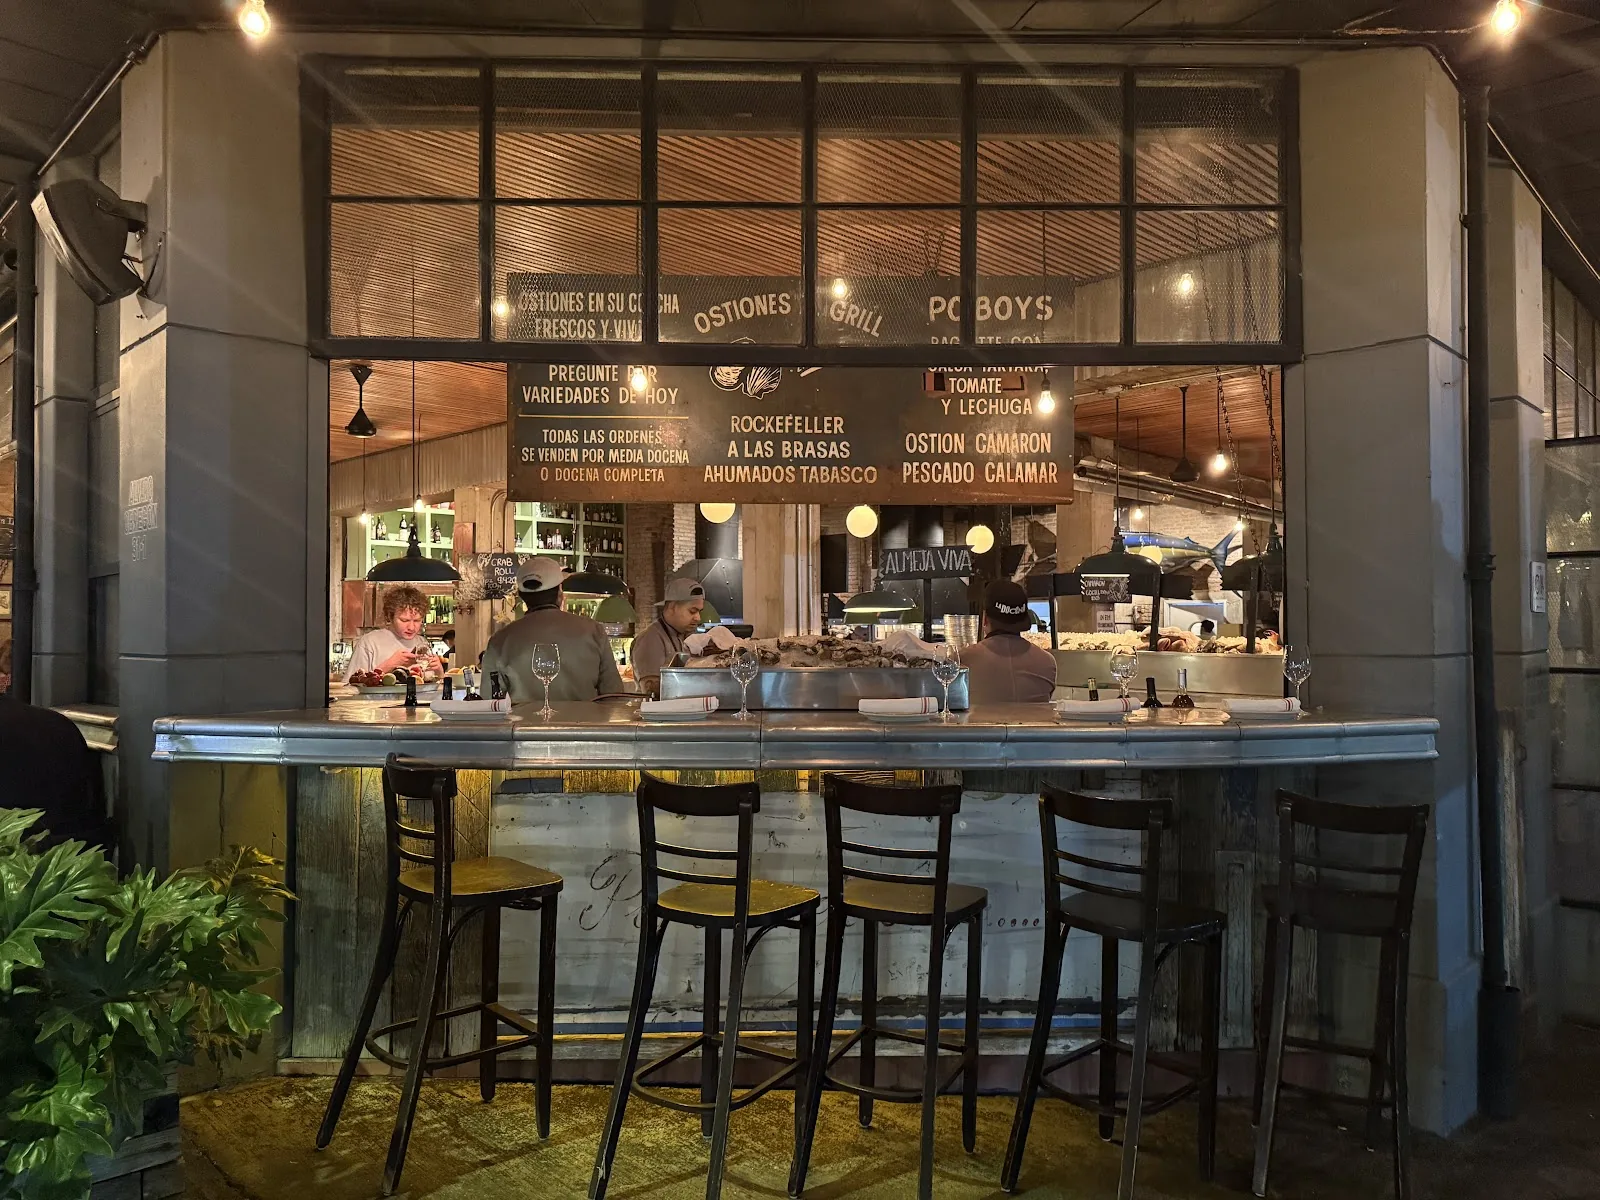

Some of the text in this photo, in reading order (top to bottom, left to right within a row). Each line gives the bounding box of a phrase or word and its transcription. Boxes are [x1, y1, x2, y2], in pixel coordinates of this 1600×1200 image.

[519, 292, 584, 313] OSTIONES
[588, 292, 604, 313] EN
[608, 292, 624, 313] SU
[975, 295, 1053, 321] BOYS
[693, 292, 883, 338] OSTIONES GRILL
[534, 318, 596, 339] FRESCOS
[600, 319, 610, 338] Y
[549, 364, 658, 383] PREGUNTE PR
[522, 385, 679, 405] VARIEDADES DE HOY
[949, 377, 1002, 394] TOMATE
[941, 398, 1033, 415] Y LECHUGA
[730, 415, 844, 434] ROCKEFELLER
[543, 429, 662, 445] TODAS LAS ORDENES
[905, 432, 1051, 454] OSTION CAMARON
[521, 447, 690, 464] SE VENDEN POR MEDIA DOCENA
[727, 440, 851, 459] A LAS BRASAS
[540, 466, 665, 482] O DOCENA COMPLETA
[703, 465, 878, 484] AHUMADOS TABASCO
[902, 461, 1058, 484] PESCADO CALAMAR
[490, 557, 513, 567] CRAB
[885, 548, 973, 574] ALMEJA VIVA
[494, 567, 515, 577] ROLL
